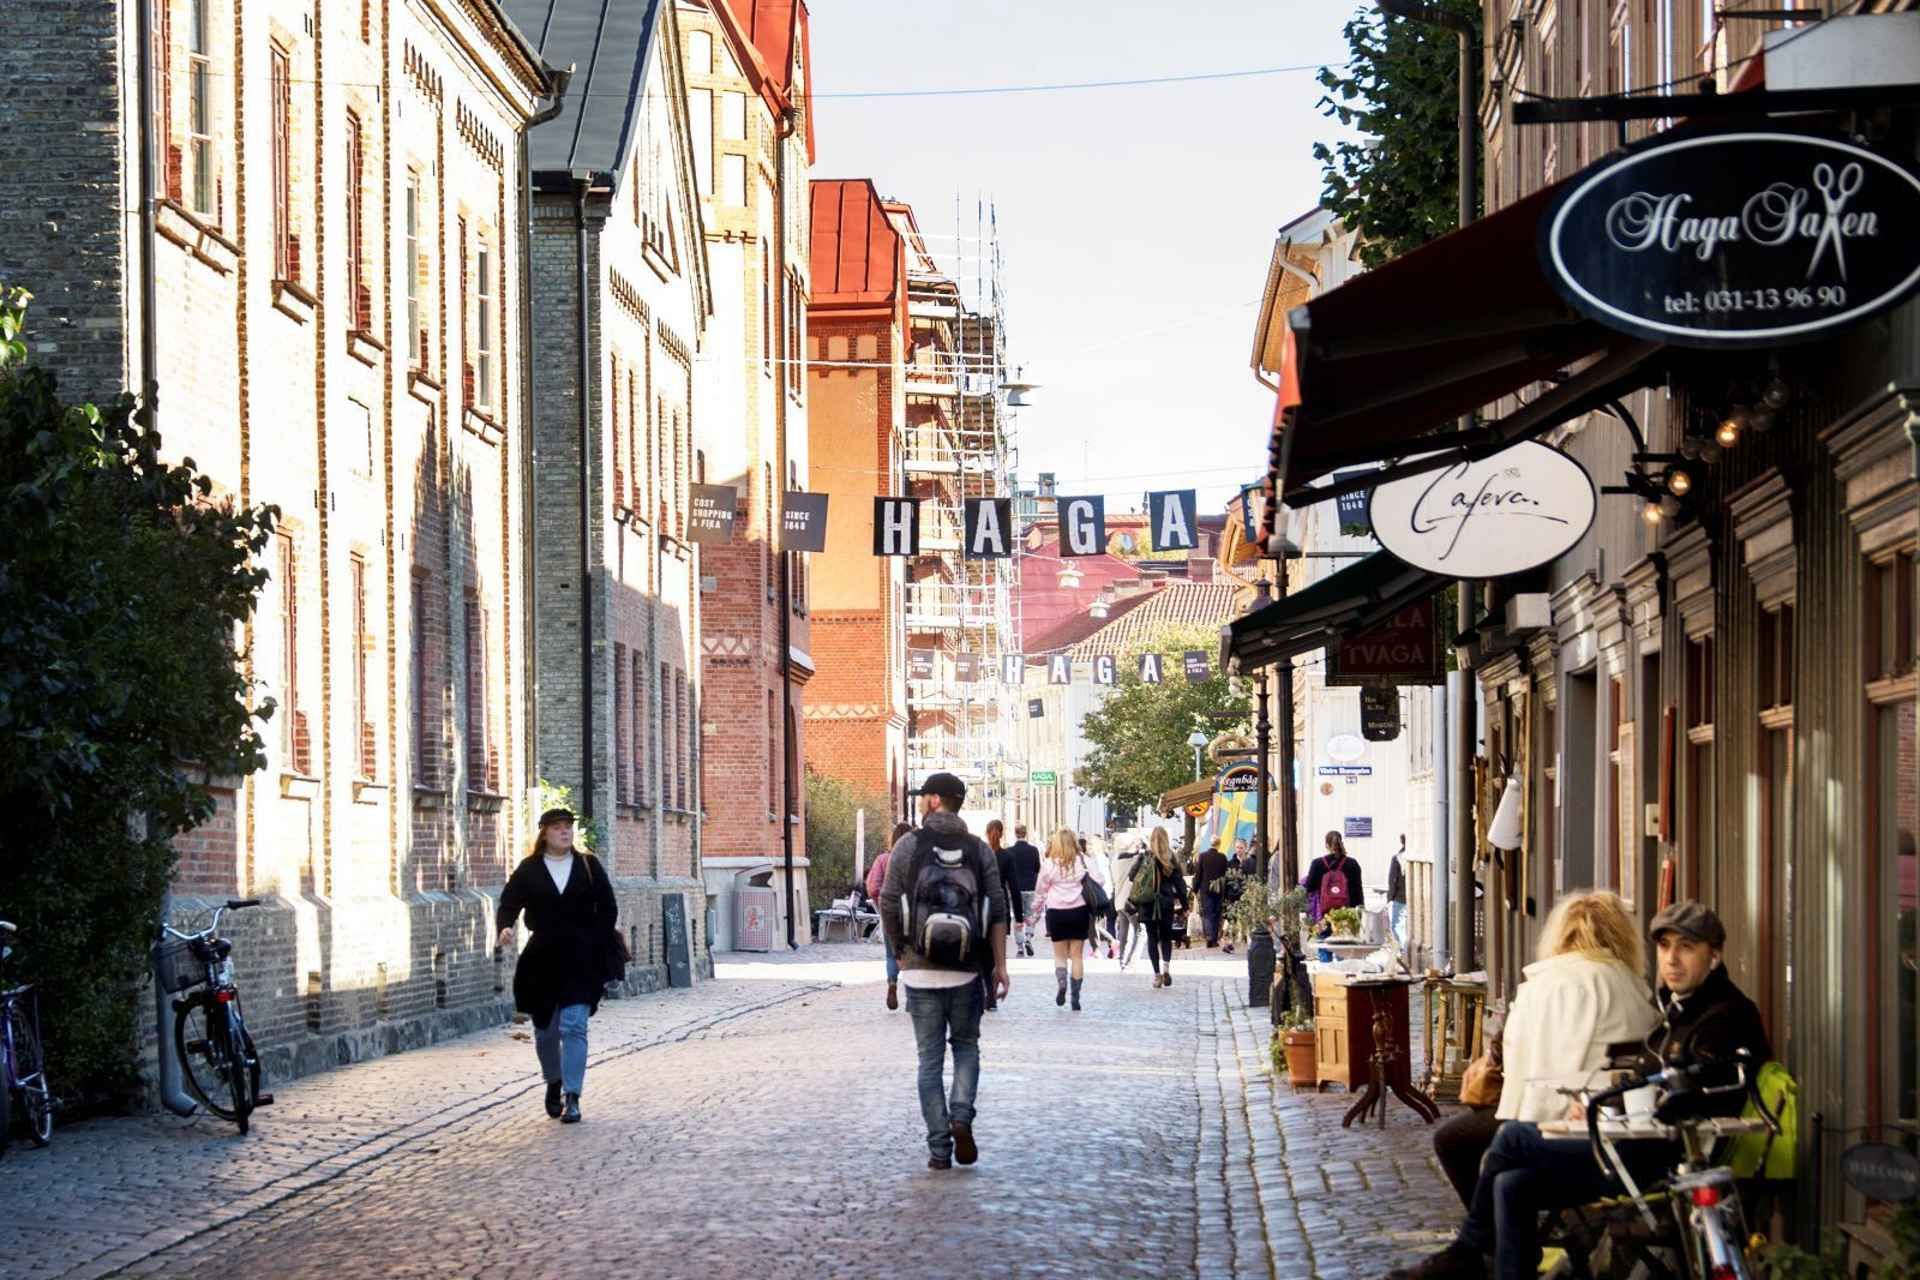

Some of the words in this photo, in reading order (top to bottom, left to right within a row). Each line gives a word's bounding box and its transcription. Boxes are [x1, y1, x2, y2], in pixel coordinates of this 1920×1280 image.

[1606, 191, 1741, 261] Haga
[1664, 291, 1700, 313] tel:
[1704, 288, 1781, 311] 031-13
[1784, 287, 1813, 308] 96
[1816, 285, 1847, 306] 90
[692, 509, 732, 520] SHOPPING
[785, 511, 810, 521] SINCE
